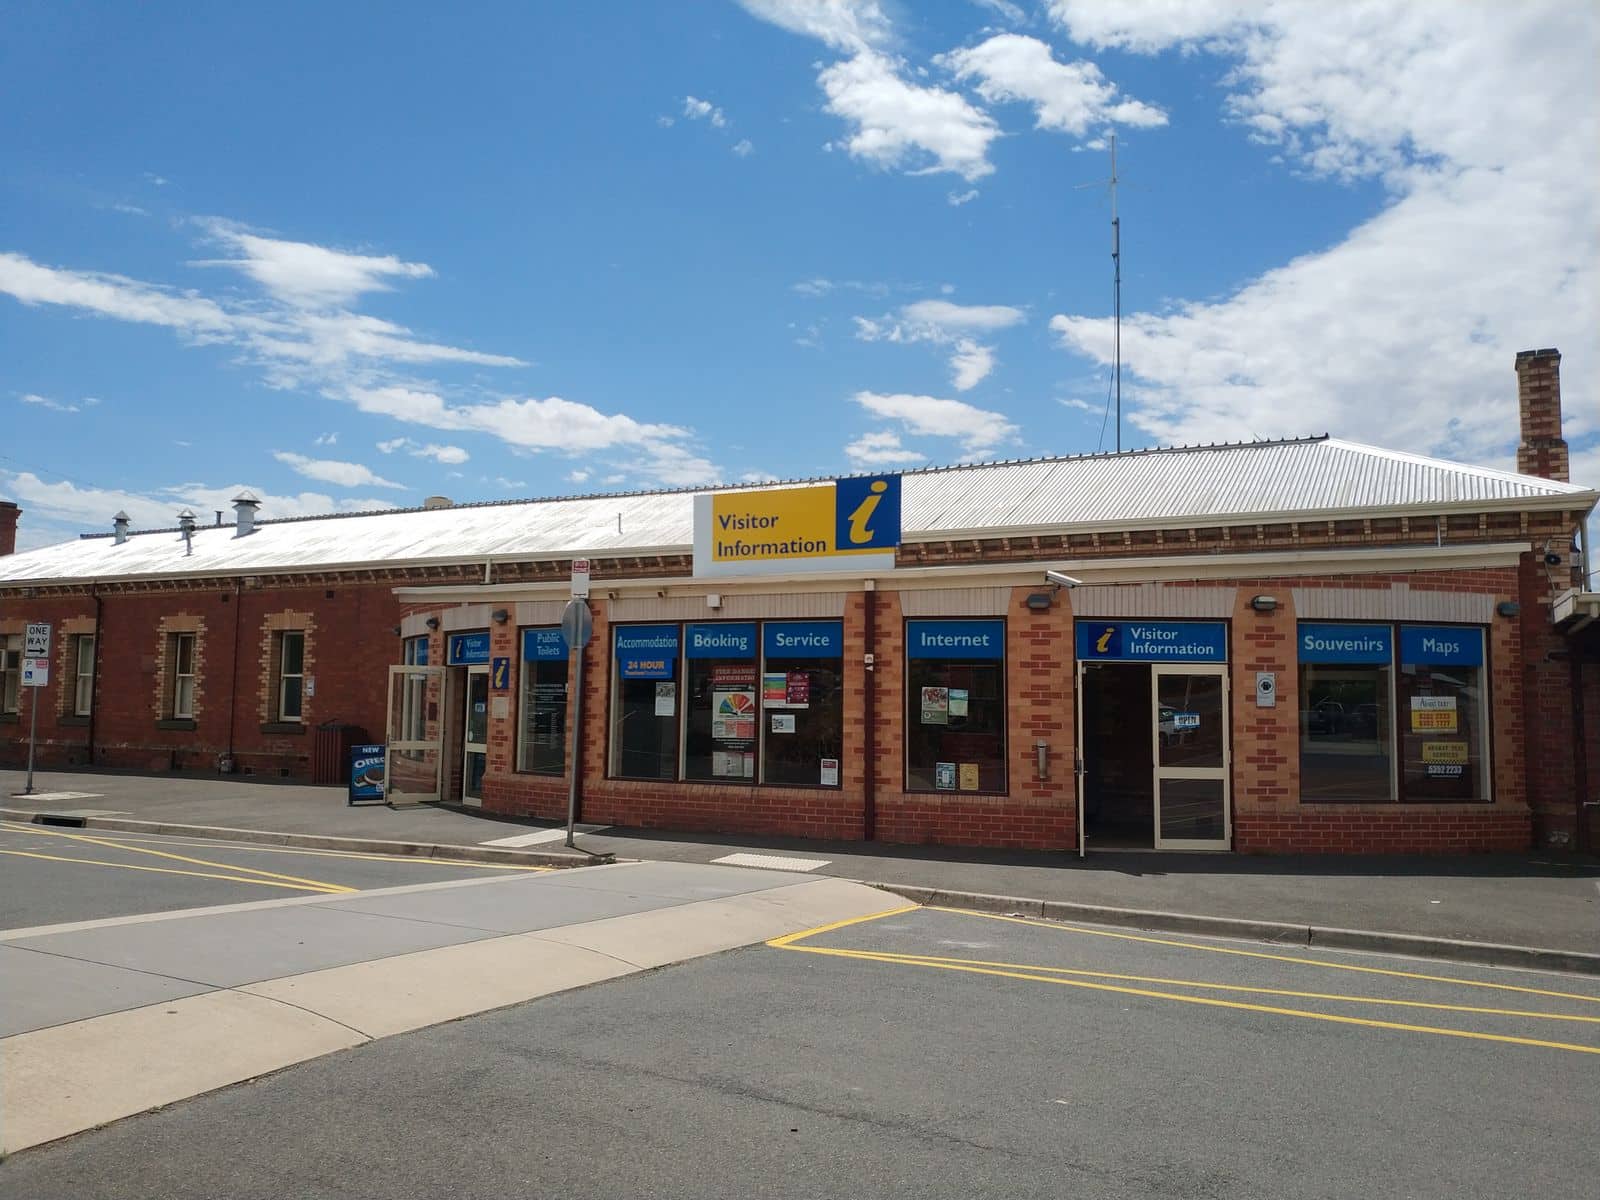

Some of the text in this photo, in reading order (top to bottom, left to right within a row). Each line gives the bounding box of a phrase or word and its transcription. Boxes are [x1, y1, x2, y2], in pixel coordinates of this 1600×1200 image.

[719, 513, 779, 530] Visitor
[718, 537, 826, 557] Information
[29, 627, 48, 635] ONE
[537, 632, 560, 643] Public
[1130, 627, 1178, 640] Visitor
[28, 637, 48, 645] WAY
[617, 635, 678, 649] Accommodation
[693, 633, 748, 650] Booking
[776, 633, 830, 647] Service
[921, 632, 990, 647] Internet
[1304, 635, 1384, 651] Souvenirs
[537, 646, 560, 655] Toilets
[1130, 642, 1214, 655] Information
[1422, 638, 1460, 656] Maps
[640, 661, 665, 669] HOUR
